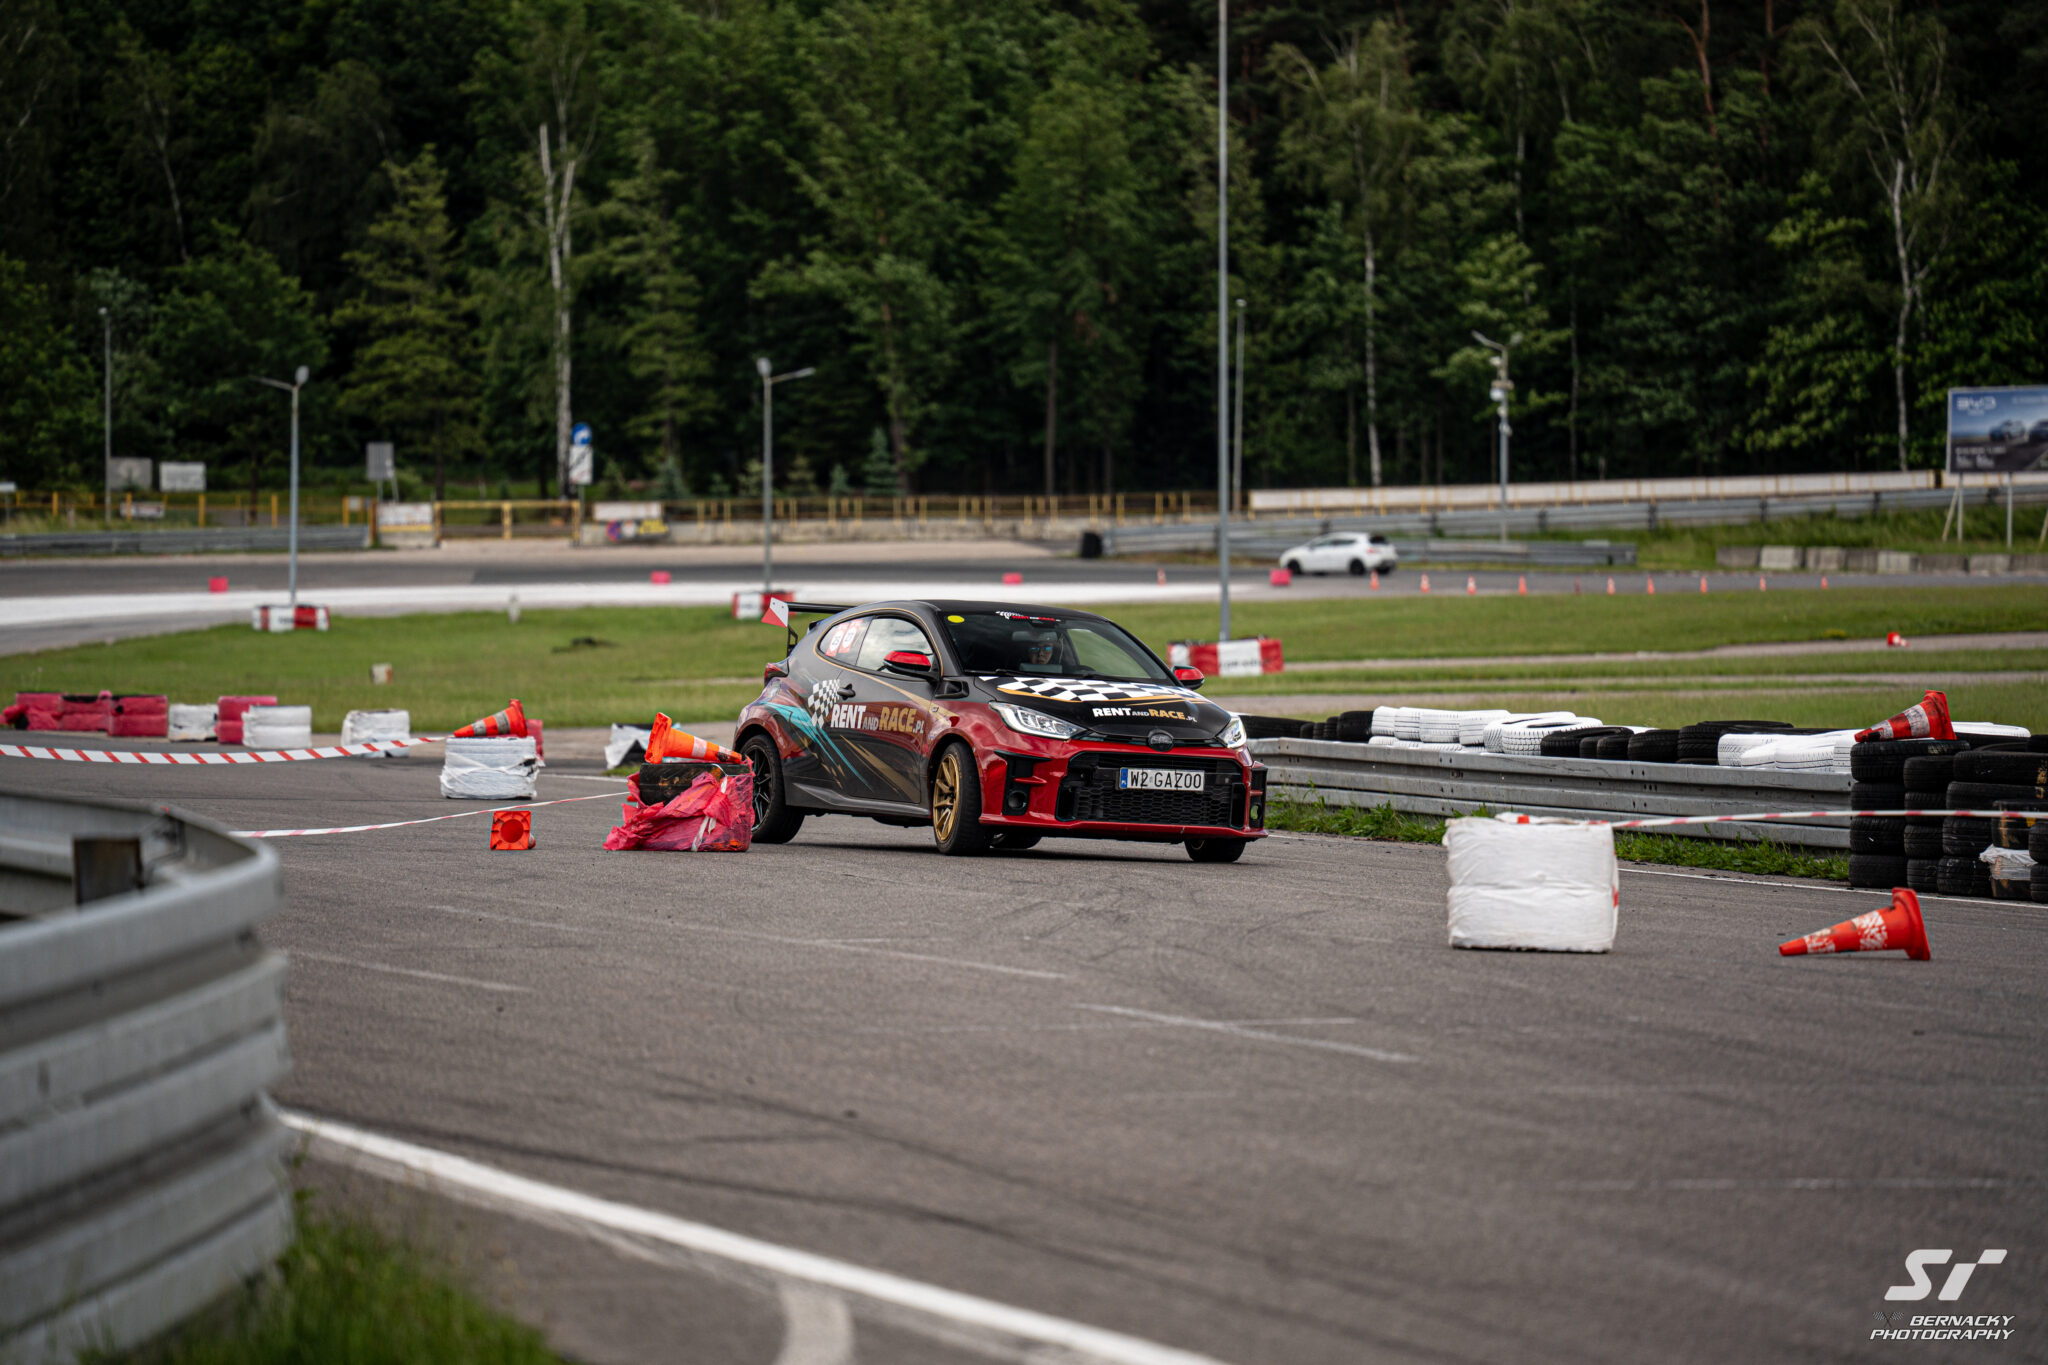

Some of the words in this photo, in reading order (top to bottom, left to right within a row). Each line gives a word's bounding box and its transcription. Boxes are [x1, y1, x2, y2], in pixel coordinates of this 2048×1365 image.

[830, 704, 866, 729] RENT
[862, 717, 879, 731] AND
[1092, 707, 1132, 718] RENT
[1131, 771, 1149, 787] W2
[1154, 772, 1202, 789] GAZOO
